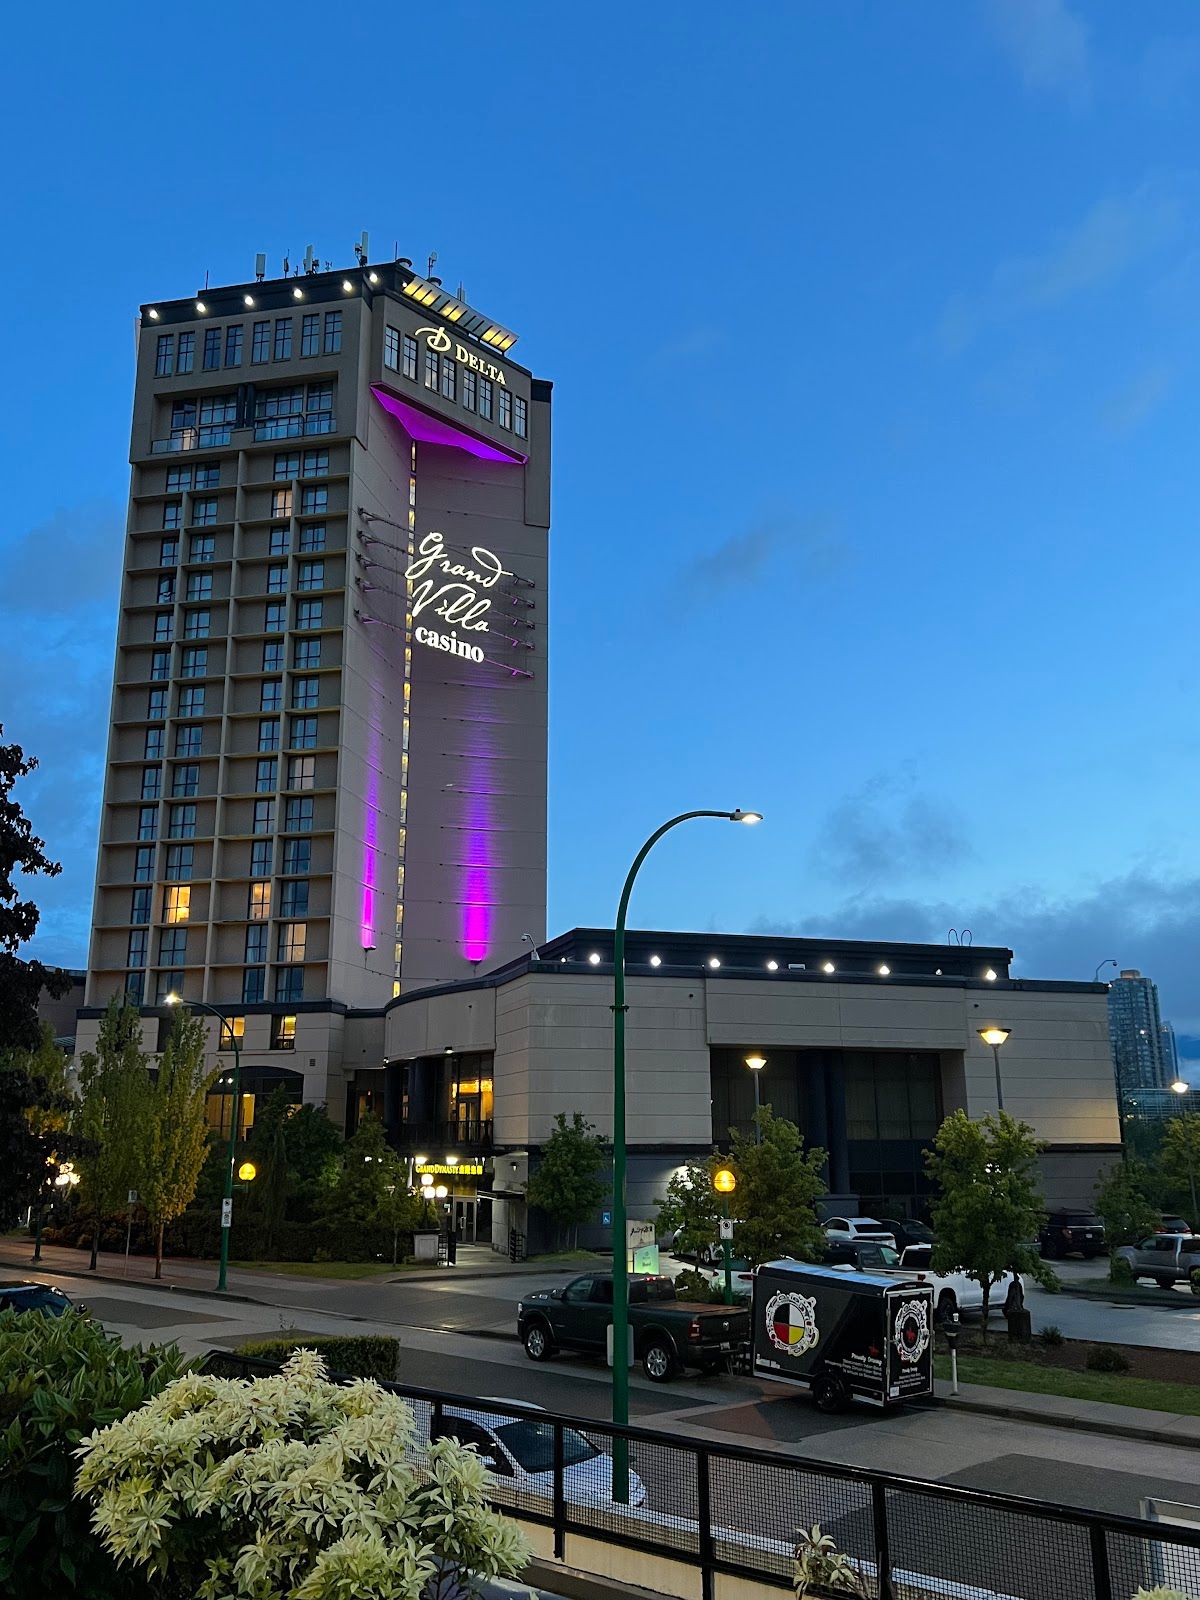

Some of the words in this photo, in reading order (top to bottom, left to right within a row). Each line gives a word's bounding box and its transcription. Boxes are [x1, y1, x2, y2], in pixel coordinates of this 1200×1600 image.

[455, 343, 506, 386] DELTA
[404, 532, 514, 588] Grand
[411, 579, 490, 632] Villa
[415, 626, 485, 663] casino
